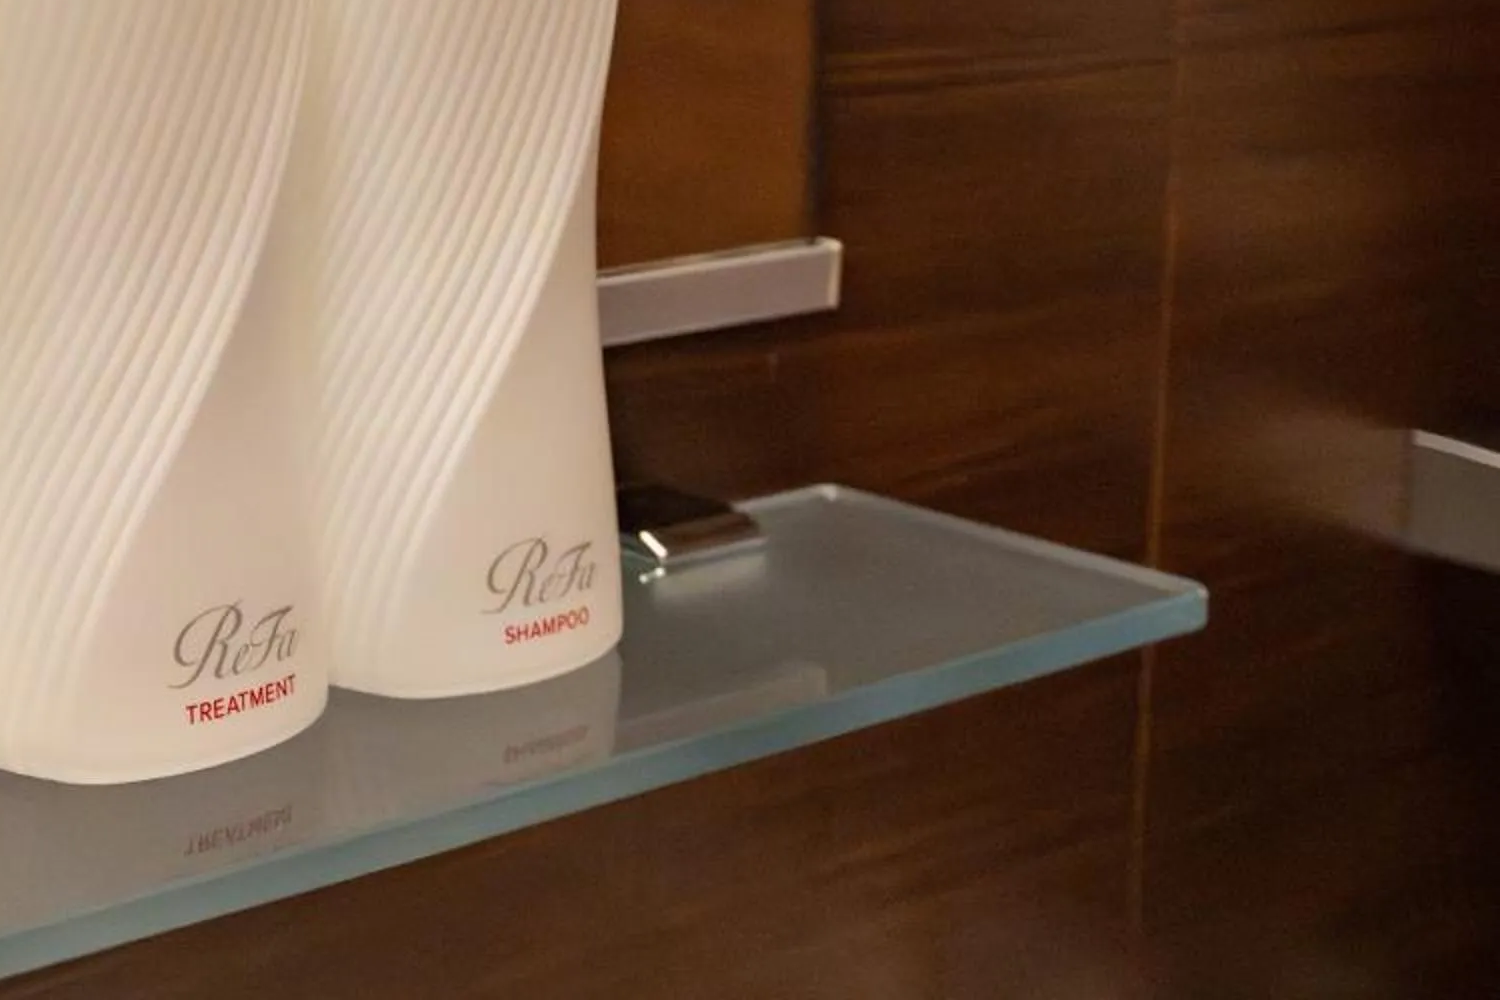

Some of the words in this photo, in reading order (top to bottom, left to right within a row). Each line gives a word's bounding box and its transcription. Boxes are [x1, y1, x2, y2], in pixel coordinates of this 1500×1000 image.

[166, 600, 299, 690] ReFa
[503, 605, 590, 645] SHAMPOO
[185, 673, 297, 726] TREATMENT
